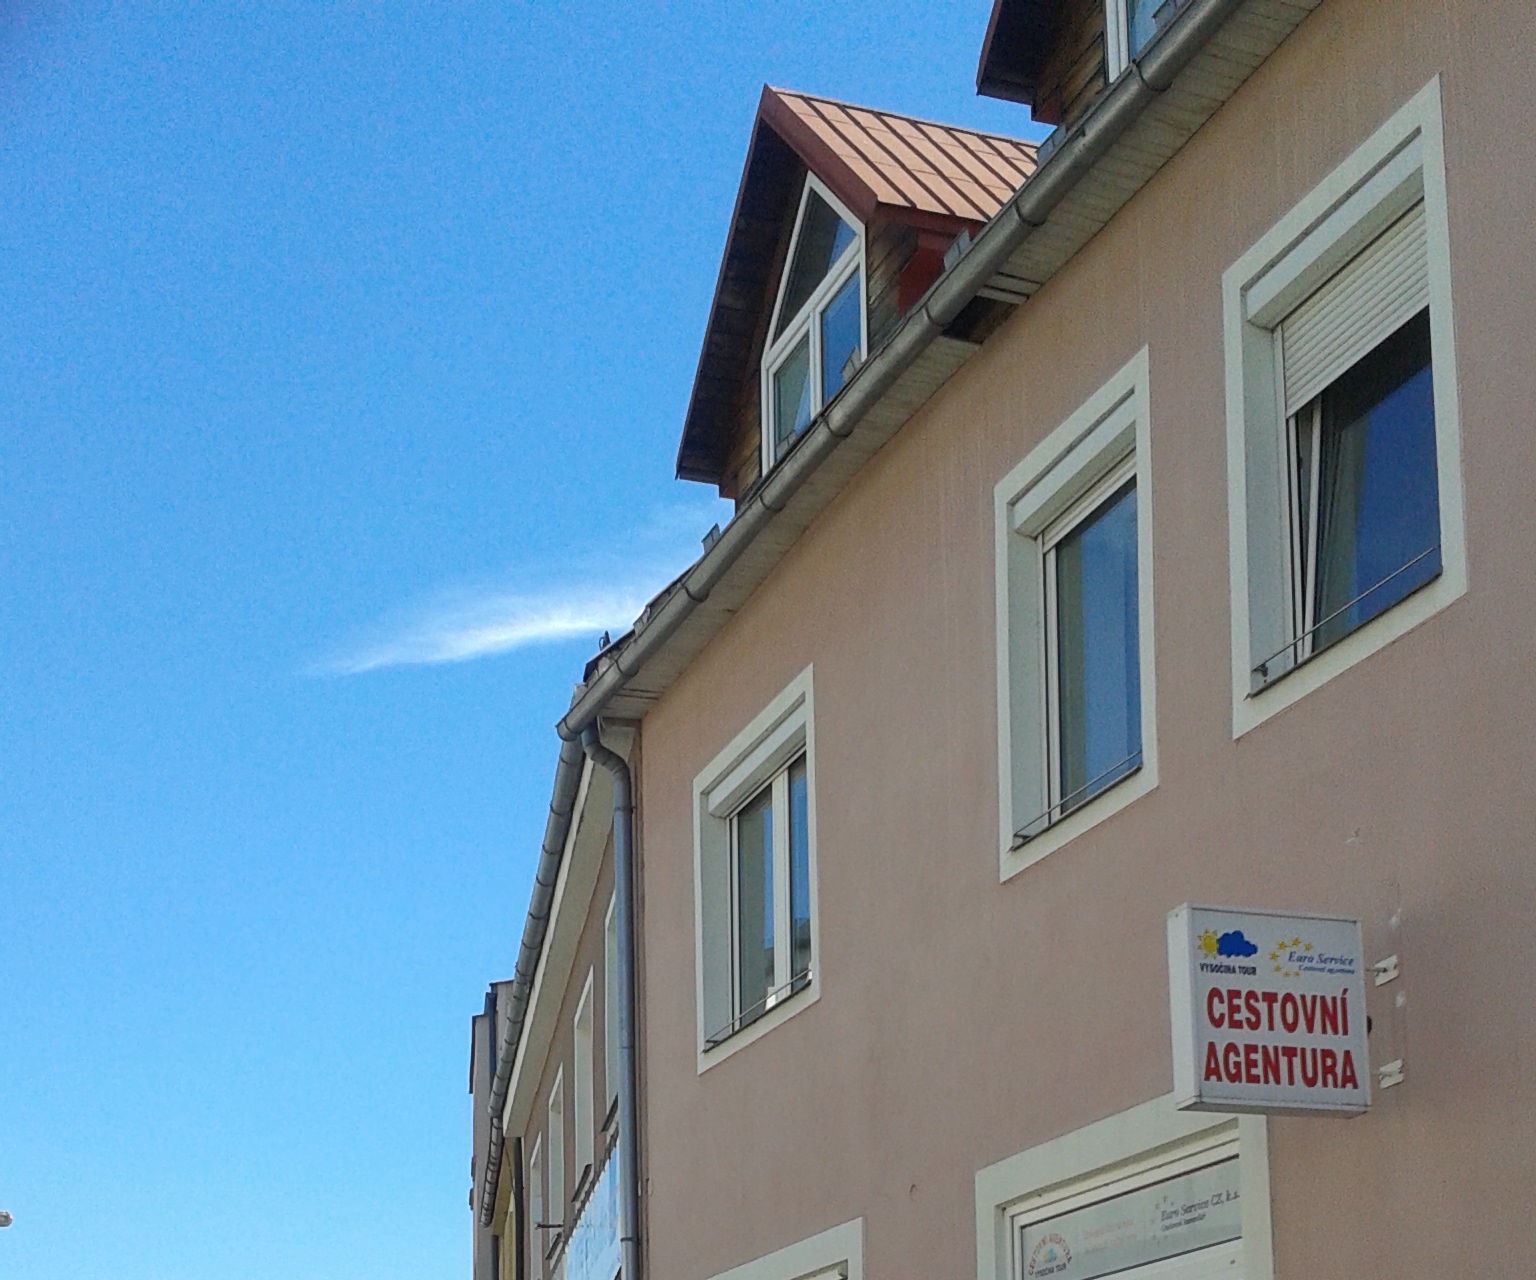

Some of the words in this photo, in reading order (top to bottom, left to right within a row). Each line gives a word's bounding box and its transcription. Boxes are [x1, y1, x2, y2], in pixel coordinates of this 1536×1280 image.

[1238, 965, 1257, 976] TOUR
[1288, 951, 1314, 964] Euro
[1317, 953, 1355, 966] Service
[1206, 987, 1349, 1036] CESTOVNÍ
[1203, 1041, 1359, 1090] AGENTURA
